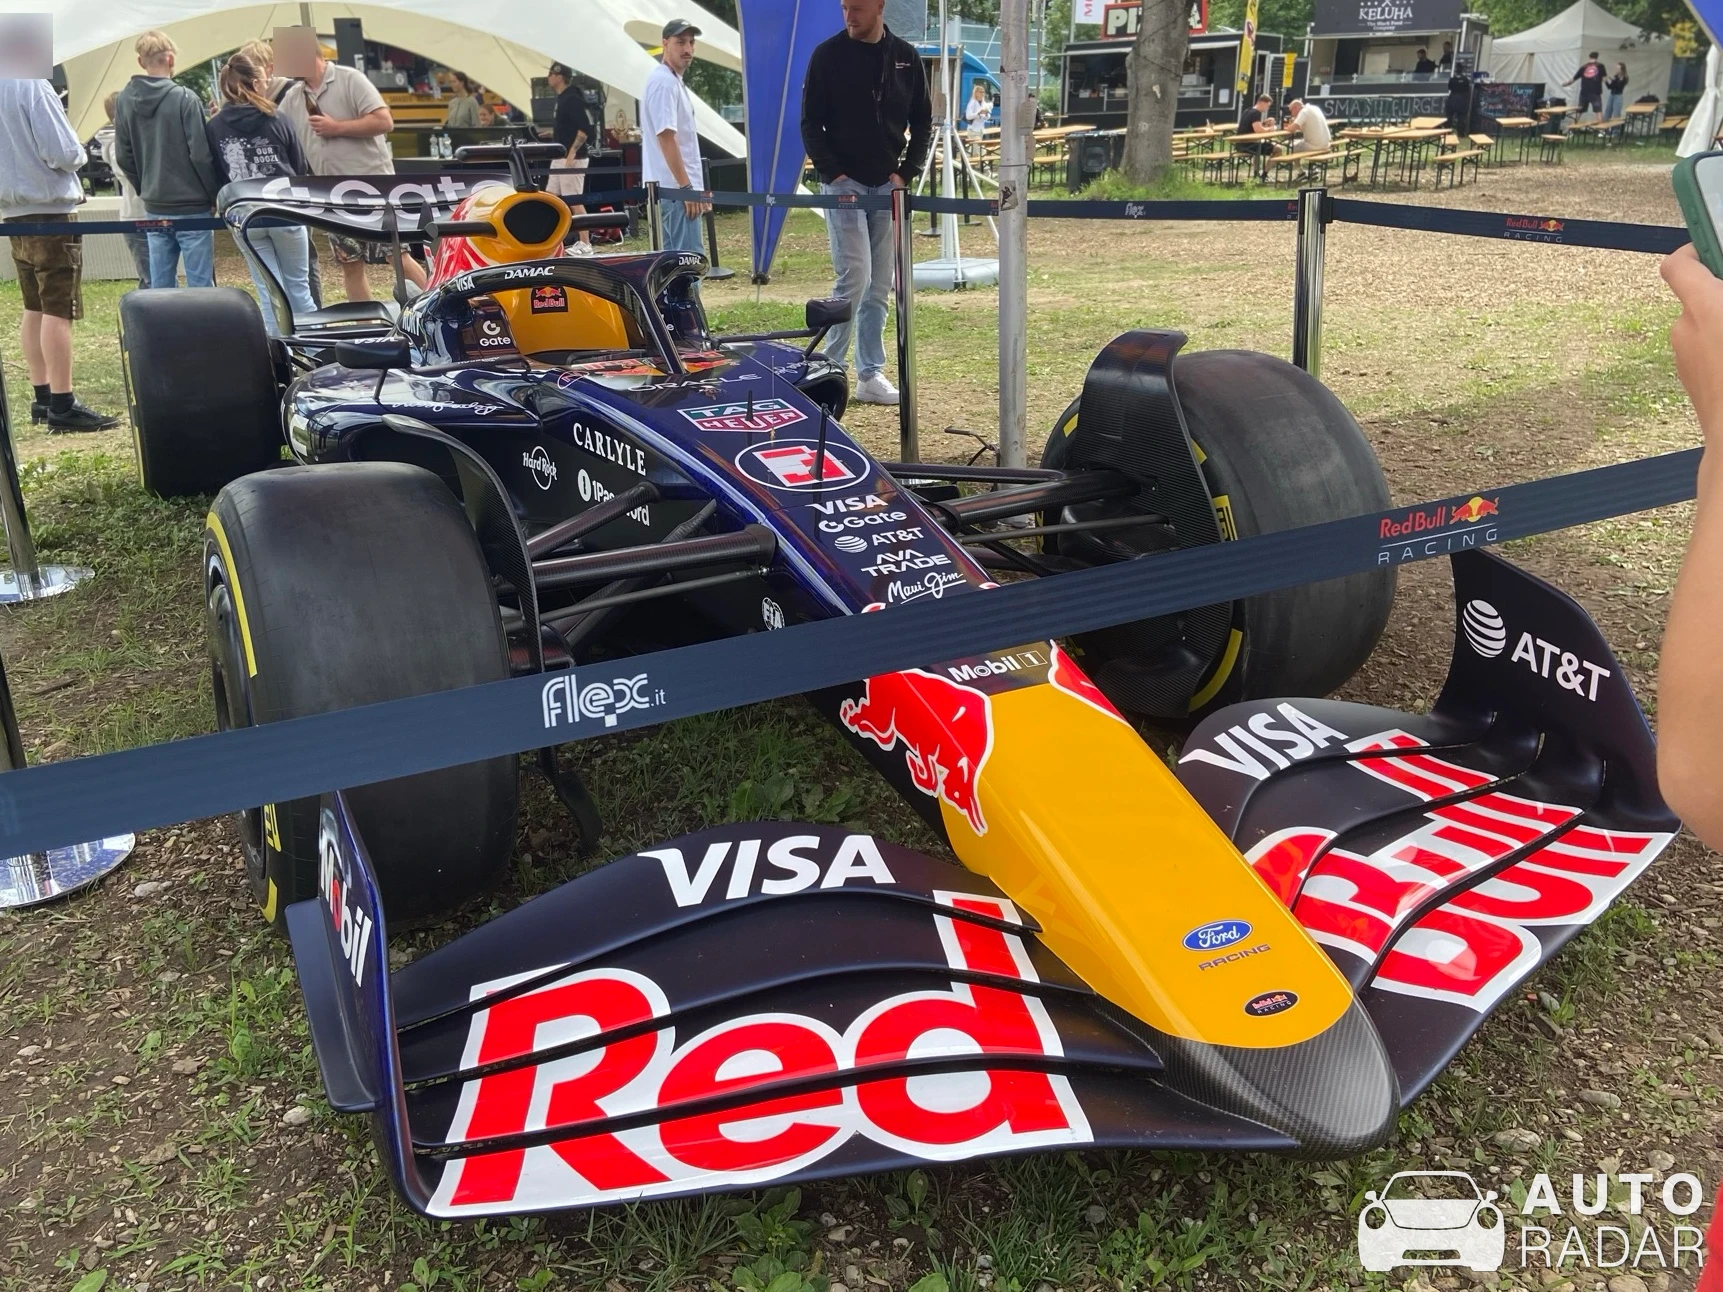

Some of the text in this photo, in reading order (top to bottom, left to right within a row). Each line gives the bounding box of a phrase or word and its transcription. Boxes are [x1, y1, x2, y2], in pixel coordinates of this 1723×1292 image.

[1107, 2, 1203, 35] PIA
[1359, 6, 1413, 20] KELUHA
[256, 147, 273, 155] OUR
[1506, 217, 1538, 229] Red Bull
[1503, 231, 1563, 243] RACING
[455, 275, 476, 292] VISA
[504, 266, 555, 280] DAMAC
[533, 296, 566, 309] Red Bull
[479, 336, 511, 347] Gate
[628, 373, 762, 392] ORACLE
[690, 400, 787, 417] TAG
[702, 411, 798, 430] HEUER
[573, 422, 647, 476] CARLYLE
[522, 452, 558, 481] Hard Rock
[592, 479, 650, 527] 1Paord
[805, 494, 889, 515] VISA
[843, 511, 907, 528] Gate
[1379, 506, 1447, 539] Red Bull
[872, 527, 925, 546] AT&T
[1377, 528, 1498, 565] RACING
[860, 554, 952, 577] TRADE
[876, 549, 925, 565] AVA
[887, 571, 964, 603] Maui Jim
[947, 655, 1022, 683] Mobil
[1511, 631, 1611, 702] AT&T
[1178, 702, 1351, 781] VISA
[637, 834, 897, 908] VISA
[320, 829, 373, 988] Mobil
[1198, 924, 1241, 948] Ford
[1198, 943, 1272, 972] RACING
[1257, 1000, 1292, 1014] RACING
[426, 890, 1094, 1217] Red
